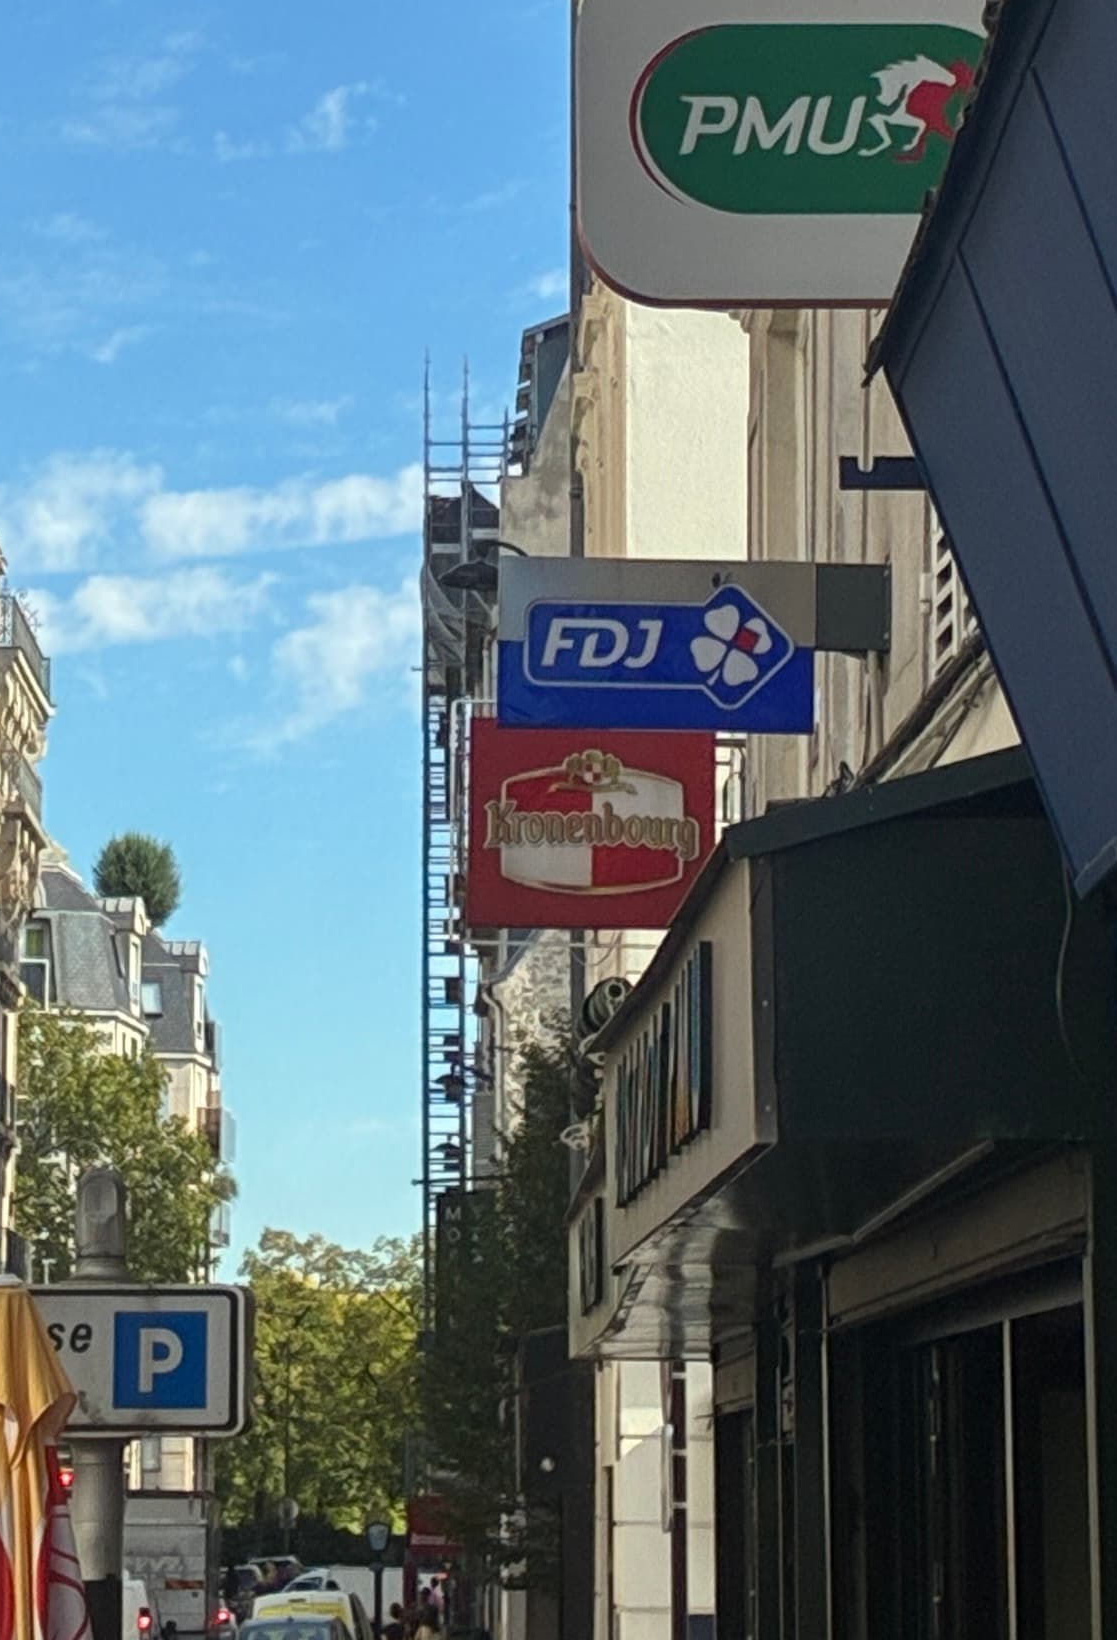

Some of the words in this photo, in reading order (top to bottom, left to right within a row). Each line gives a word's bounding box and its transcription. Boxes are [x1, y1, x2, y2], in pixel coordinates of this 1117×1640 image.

[678, 95, 866, 156] PMU
[541, 617, 664, 669] FDJ
[484, 800, 700, 860] Kronenbourg
[138, 1327, 183, 1394] P
